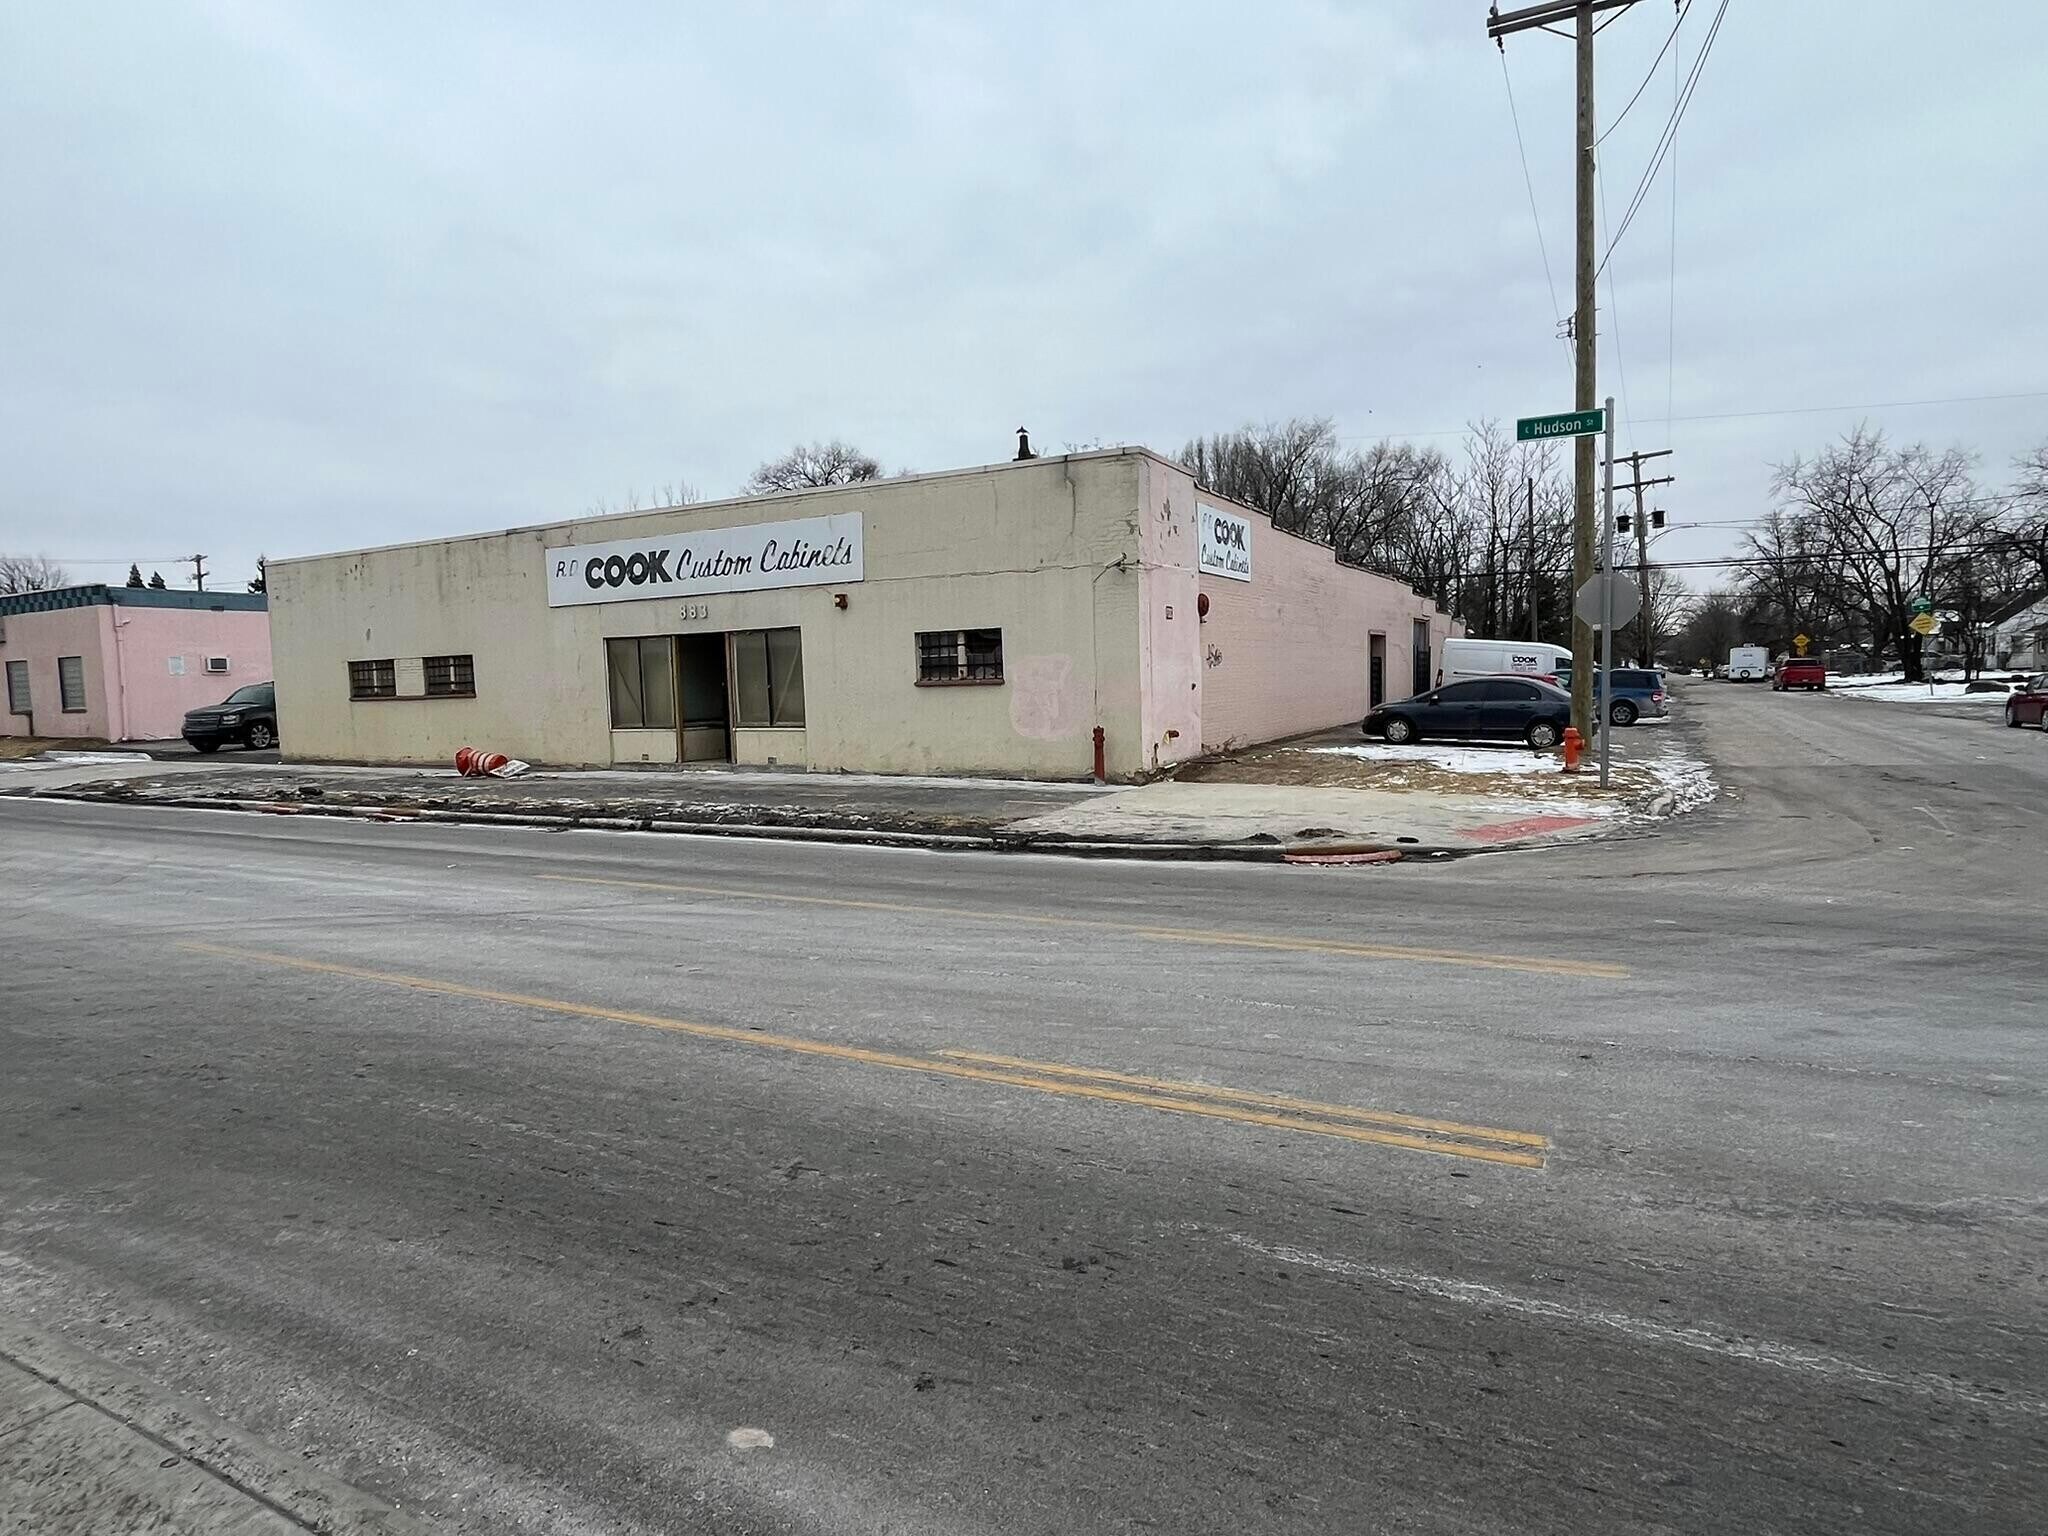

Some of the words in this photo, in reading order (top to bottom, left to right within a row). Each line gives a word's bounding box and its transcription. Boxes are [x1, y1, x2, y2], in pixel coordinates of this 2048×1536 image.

[1534, 420, 1582, 435] Hudson
[1214, 518, 1246, 551] COOK
[584, 549, 673, 589] COOK
[676, 549, 753, 581] Custom
[759, 536, 853, 573] Cabinets
[680, 603, 708, 620] 883
[1512, 656, 1537, 664] COOK
